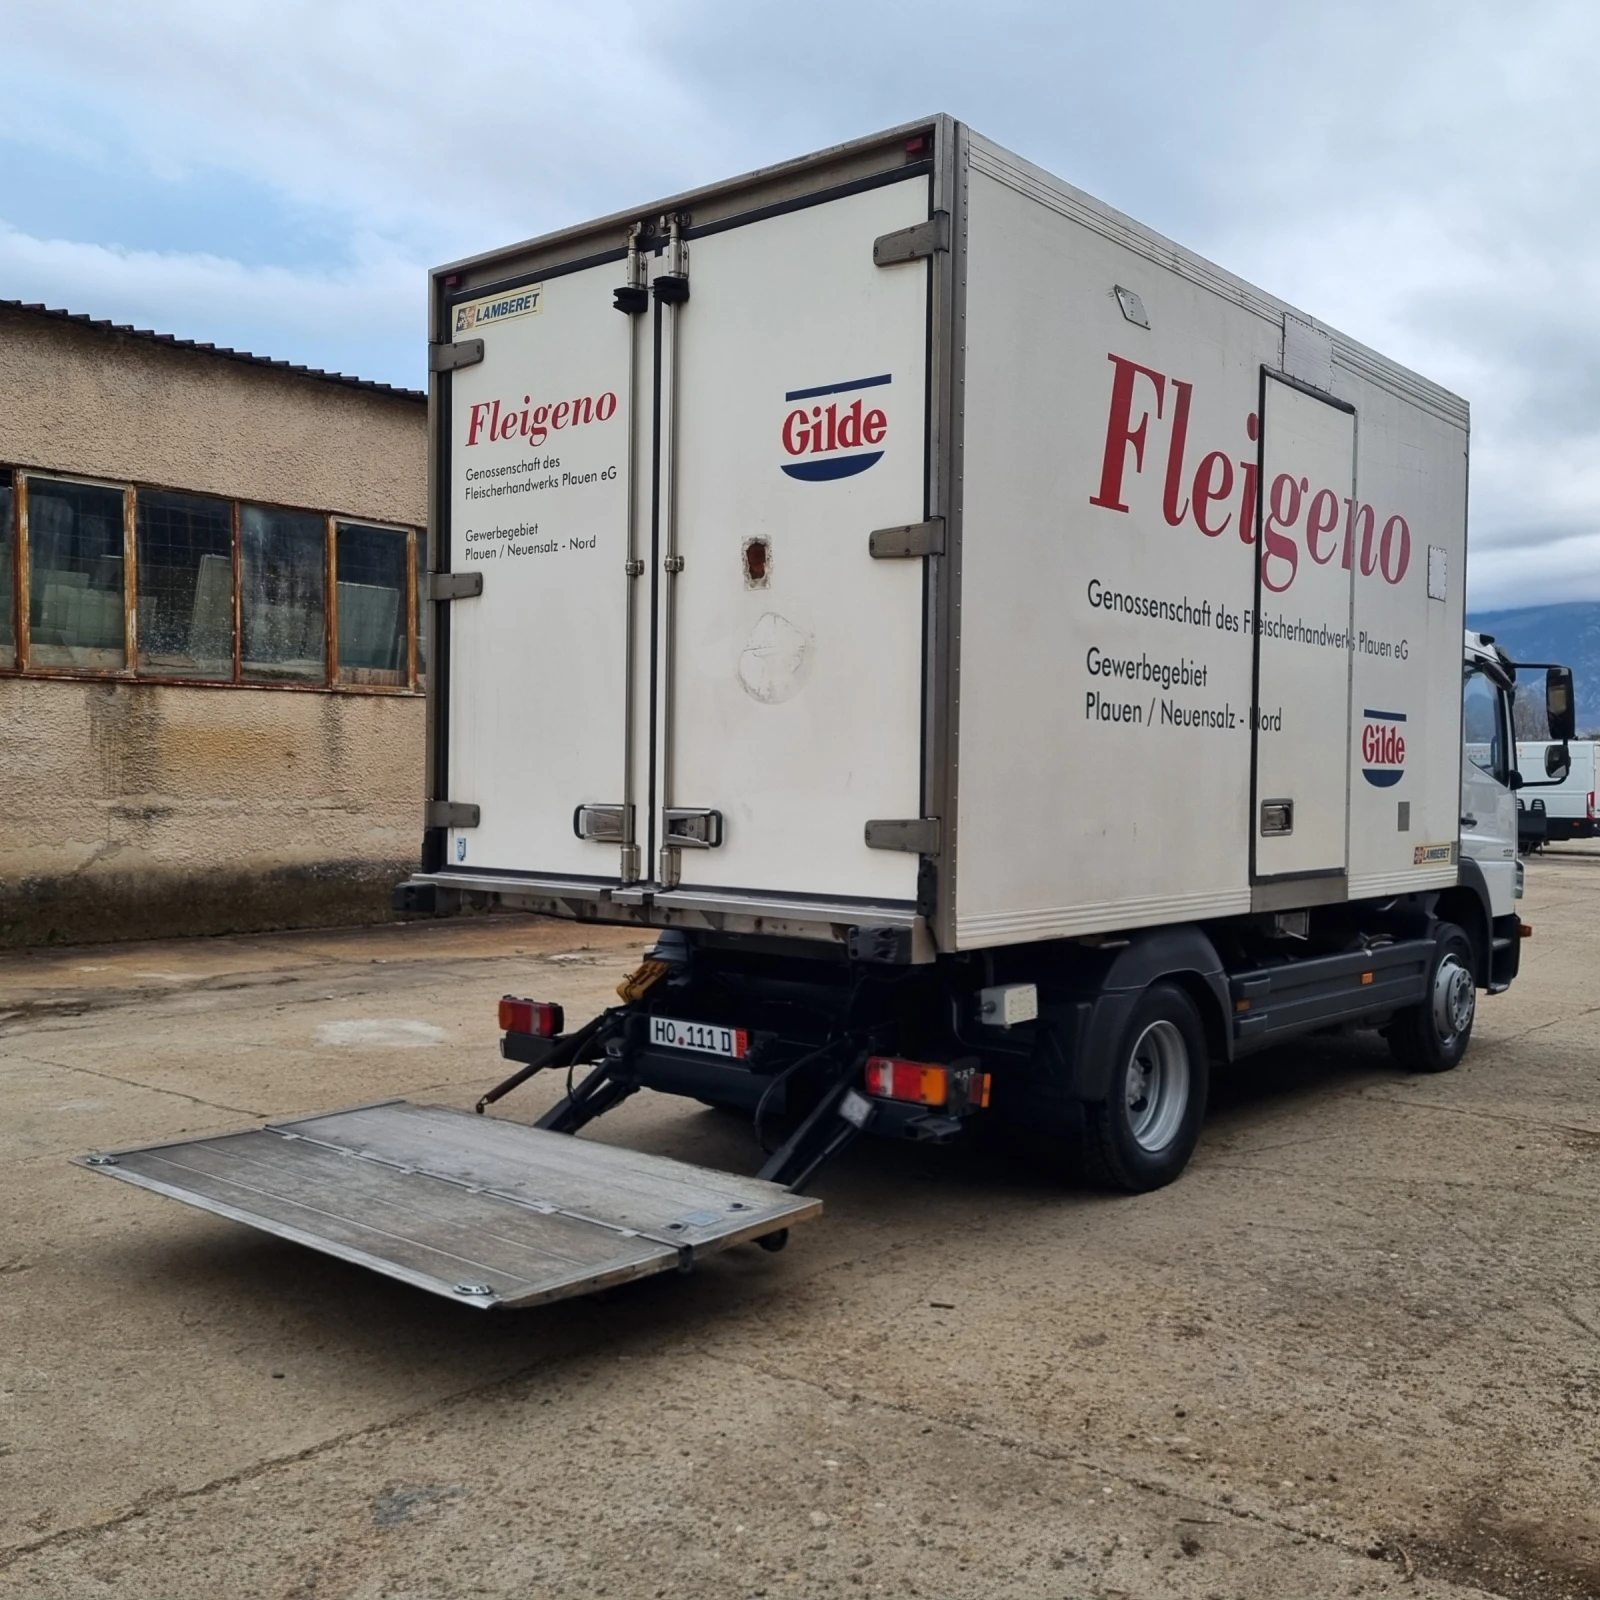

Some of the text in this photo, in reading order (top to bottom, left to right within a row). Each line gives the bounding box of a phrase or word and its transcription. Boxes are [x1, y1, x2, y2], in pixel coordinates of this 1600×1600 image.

[476, 292, 540, 323] LAMBERET
[465, 391, 617, 447] Fleigeno
[782, 398, 888, 456] Gilde
[465, 455, 561, 481] Genossenschaft des
[465, 466, 617, 500] Fleischerhandwerks Plauen eG
[1089, 353, 1411, 593] Fleigeno
[465, 523, 539, 542] Gewerbegebiet
[465, 548, 497, 561] Plauen
[507, 540, 559, 557] Neuensalz
[569, 535, 596, 550] Nord
[1088, 579, 1211, 627] Genossenschaft
[1216, 604, 1239, 632] des
[1359, 631, 1392, 658] Plauen
[1394, 639, 1409, 661] eG
[1086, 647, 1208, 691] Gewerbegebiet
[1086, 691, 1142, 723] Plauen
[1161, 699, 1236, 729] Neuensalz
[1362, 724, 1406, 765] Gilde
[655, 1020, 676, 1044] HO
[687, 1025, 717, 1051] 111
[721, 1031, 732, 1053] D
